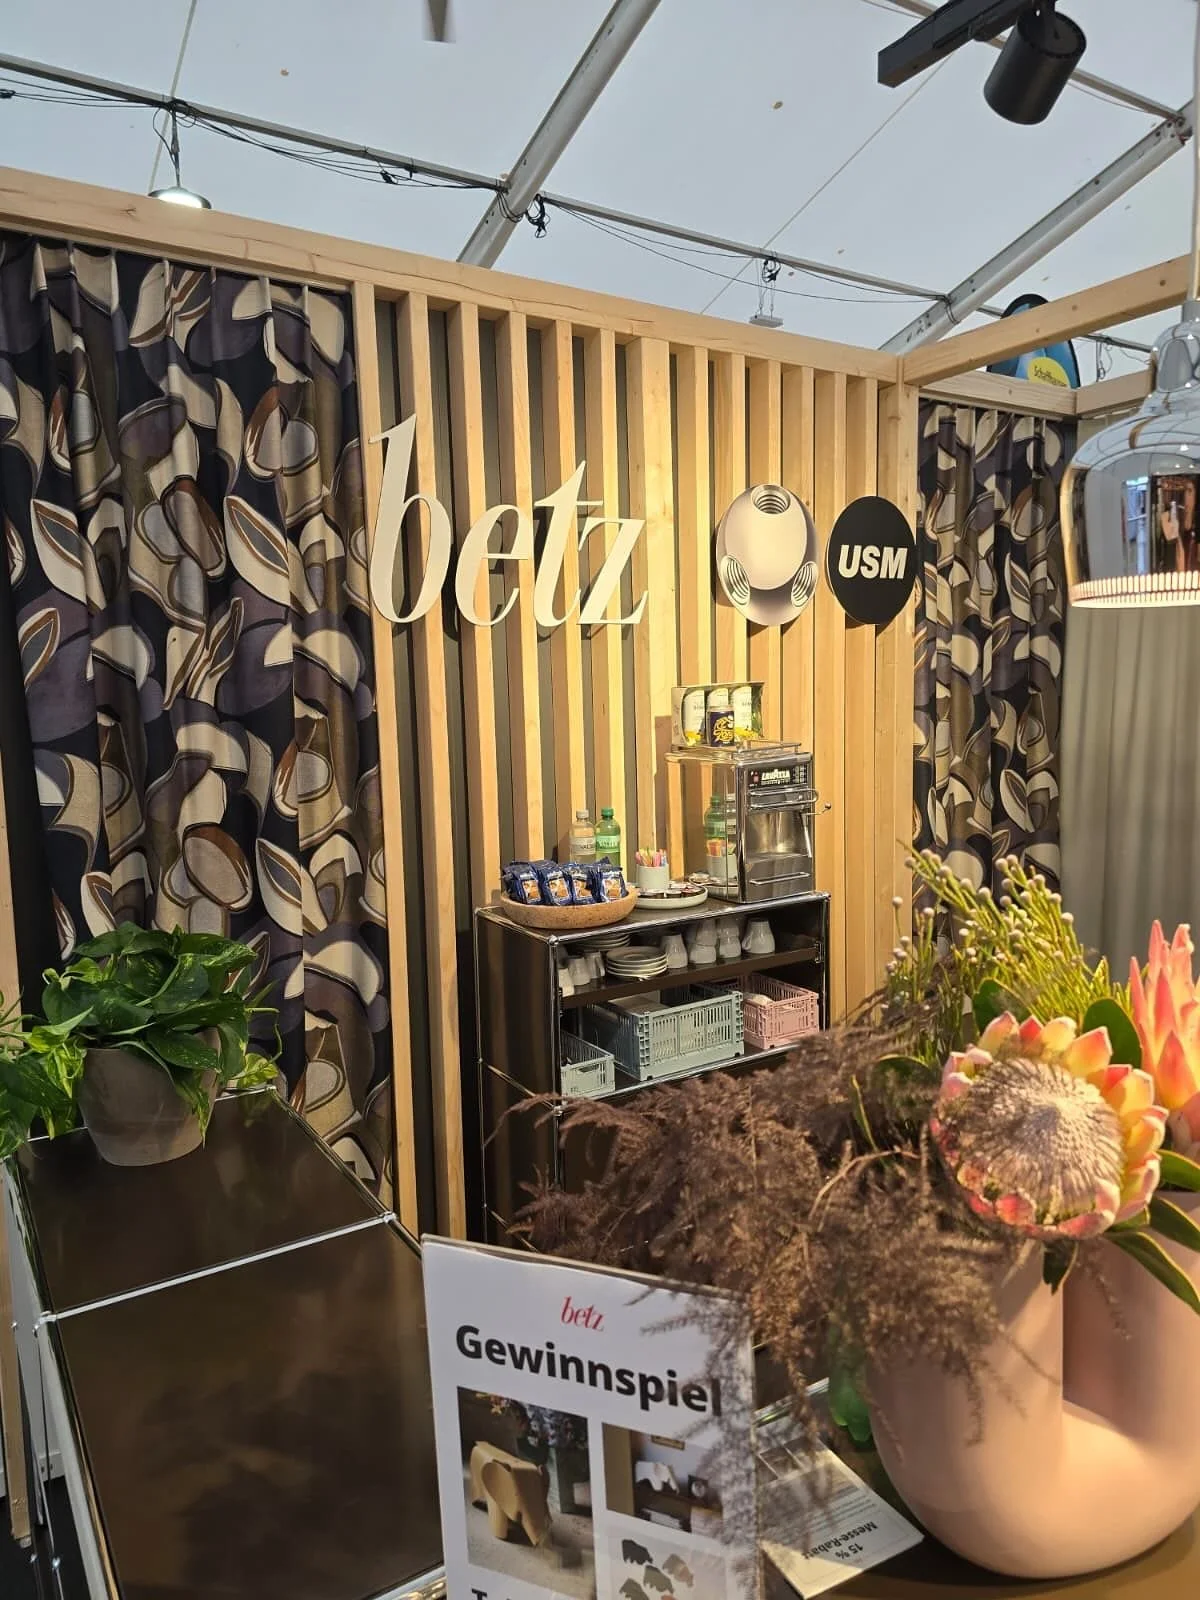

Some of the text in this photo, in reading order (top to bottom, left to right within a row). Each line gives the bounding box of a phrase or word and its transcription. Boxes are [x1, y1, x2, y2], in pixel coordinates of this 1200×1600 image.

[369, 413, 648, 627] betz
[838, 543, 907, 580] USM
[561, 1296, 604, 1332] betz
[456, 1324, 723, 1416] Gewinnspiel
[835, 1543, 864, 1559] 15 %
